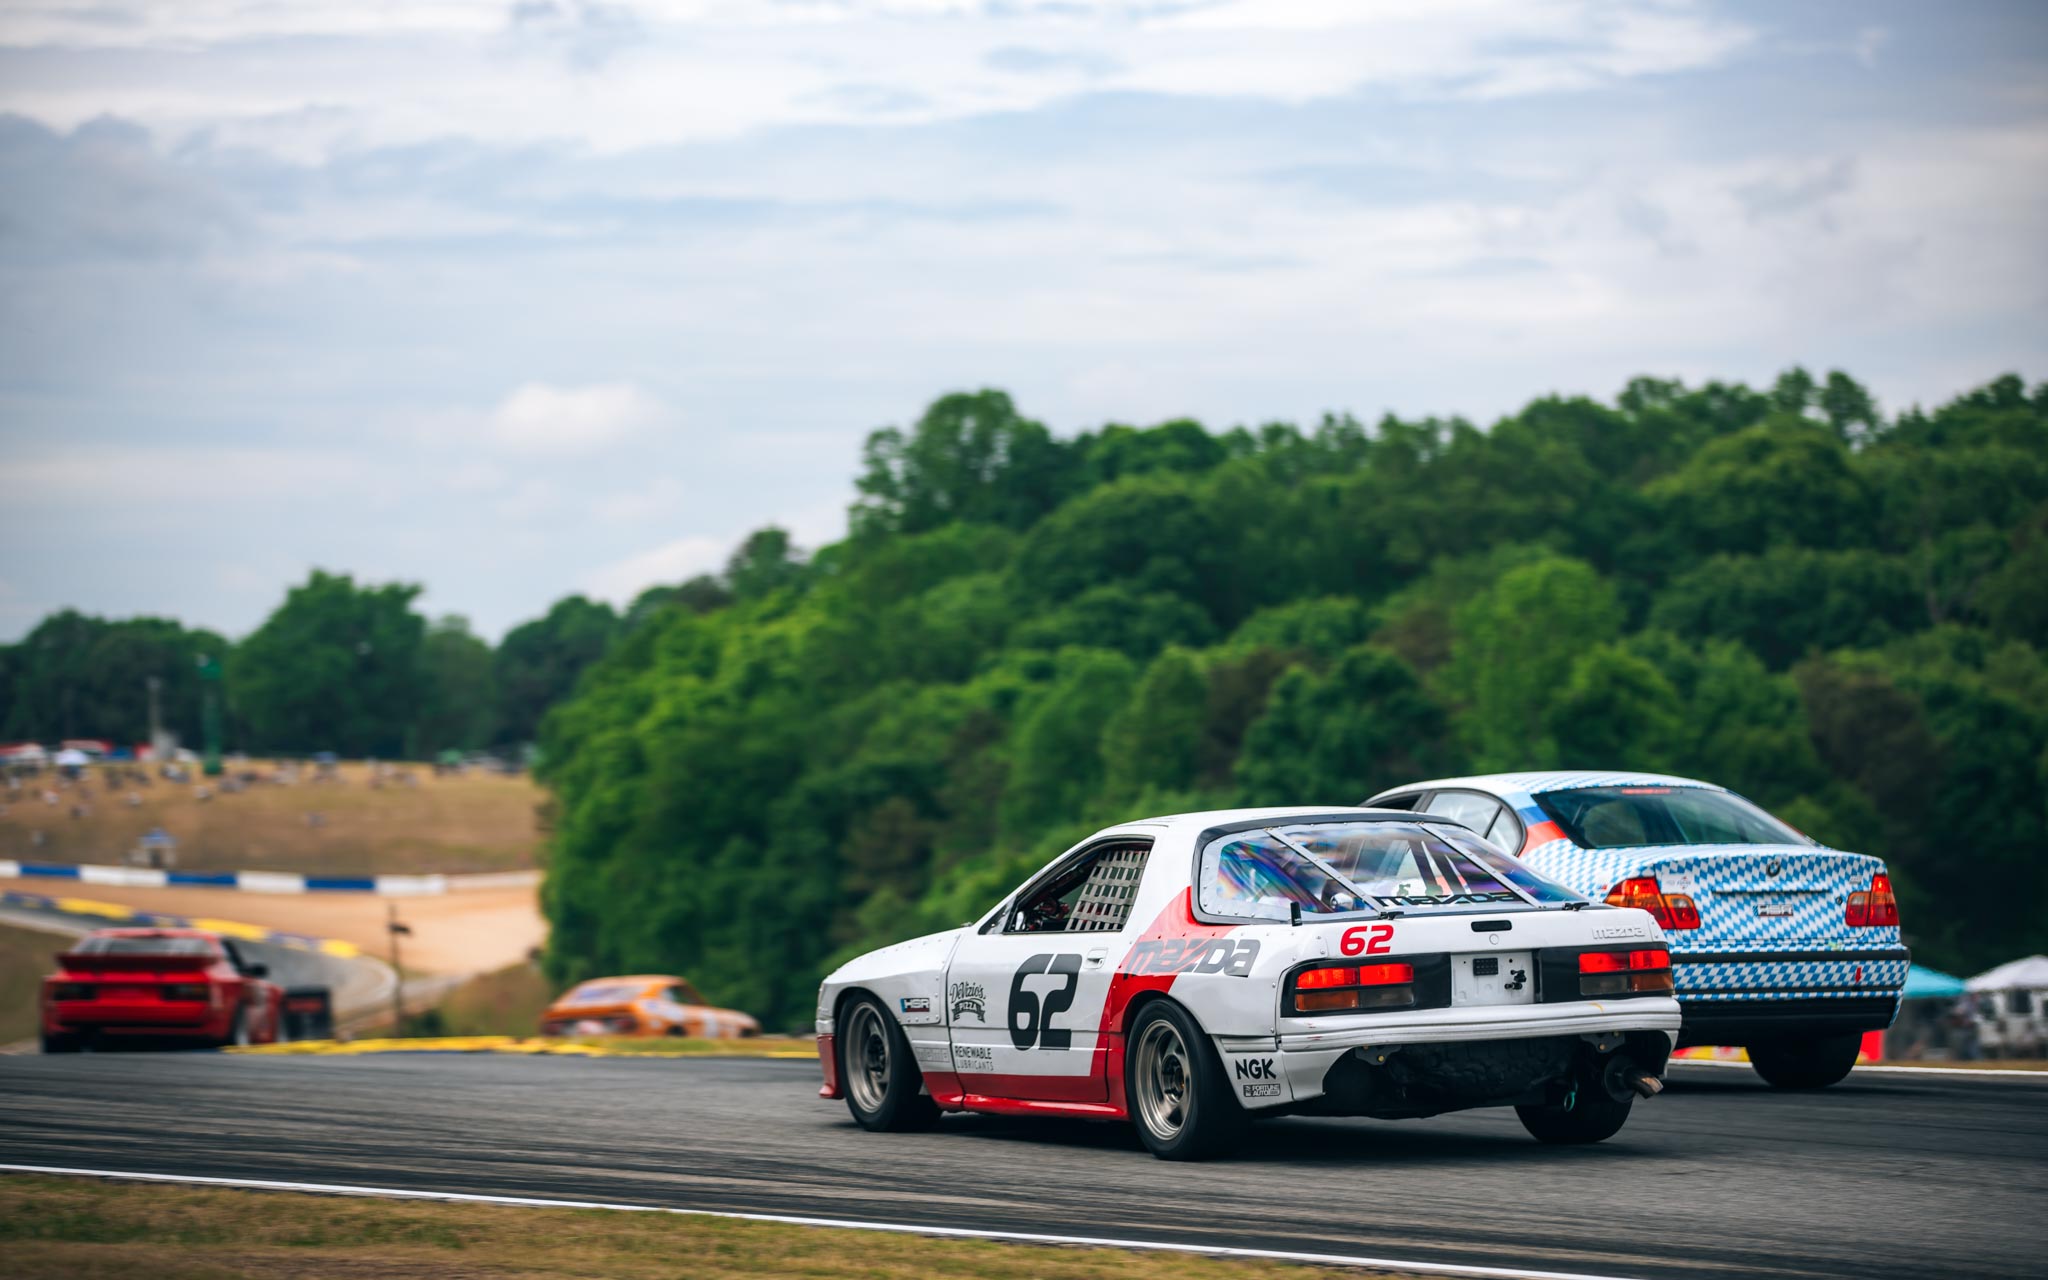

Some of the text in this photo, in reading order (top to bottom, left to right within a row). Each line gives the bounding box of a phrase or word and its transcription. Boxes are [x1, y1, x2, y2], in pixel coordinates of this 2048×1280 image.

[1373, 892, 1523, 906] mazda
[1340, 924, 1394, 956] 62
[1592, 927, 1646, 939] mazda
[1126, 938, 1261, 977] mazda
[905, 998, 930, 1009] HSR
[958, 1001, 978, 1012] PIZZA
[1008, 953, 1083, 1051] 62
[955, 1046, 992, 1060] RENEWABLE
[957, 1060, 994, 1072] LUBRICANTS
[1235, 1058, 1277, 1080] NGK
